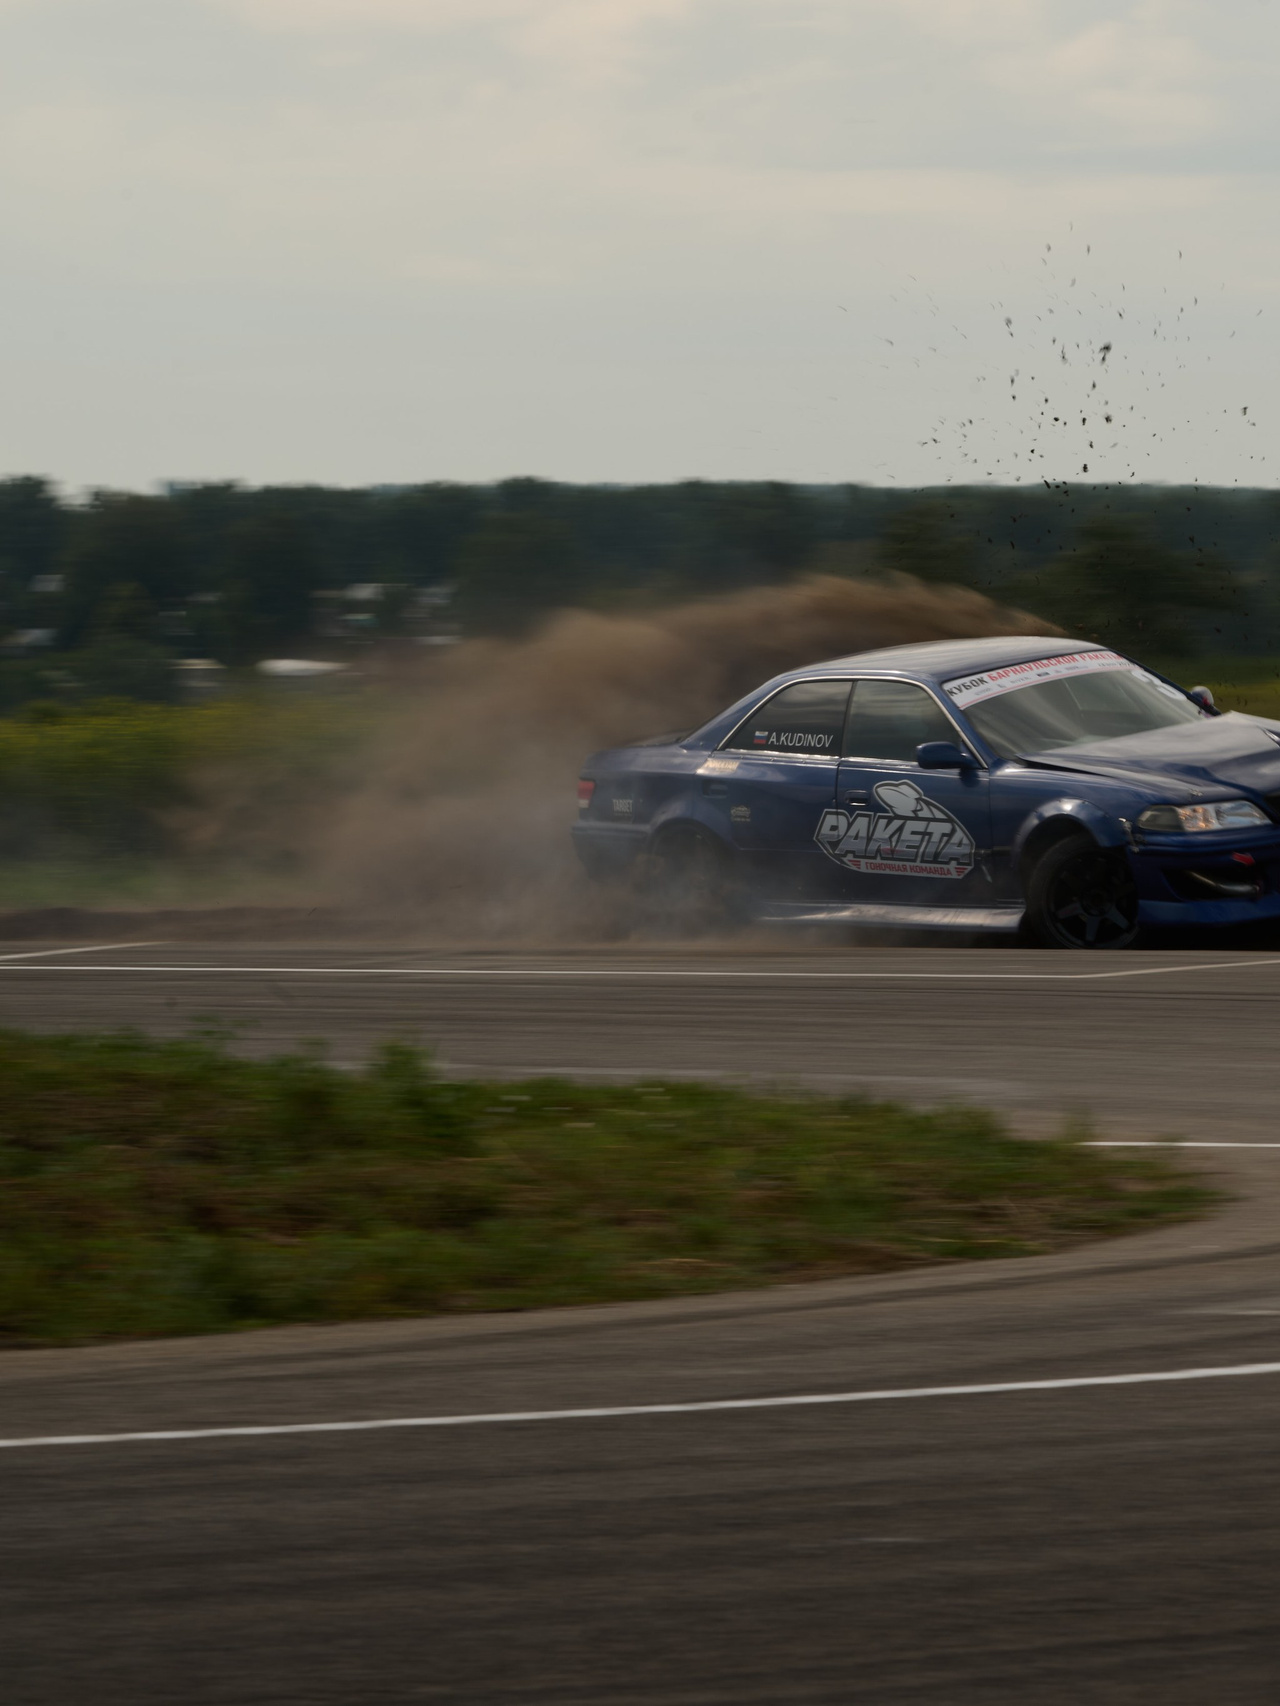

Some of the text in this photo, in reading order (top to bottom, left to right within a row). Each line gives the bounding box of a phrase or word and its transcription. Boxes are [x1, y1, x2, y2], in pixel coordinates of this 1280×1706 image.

[946, 676, 988, 697] КУБОК
[768, 732, 834, 748] A.KUDINOV
[816, 812, 972, 863] РАКЕТА
[865, 861, 952, 877] ГОНОЧНАЯ КОМАНДА
